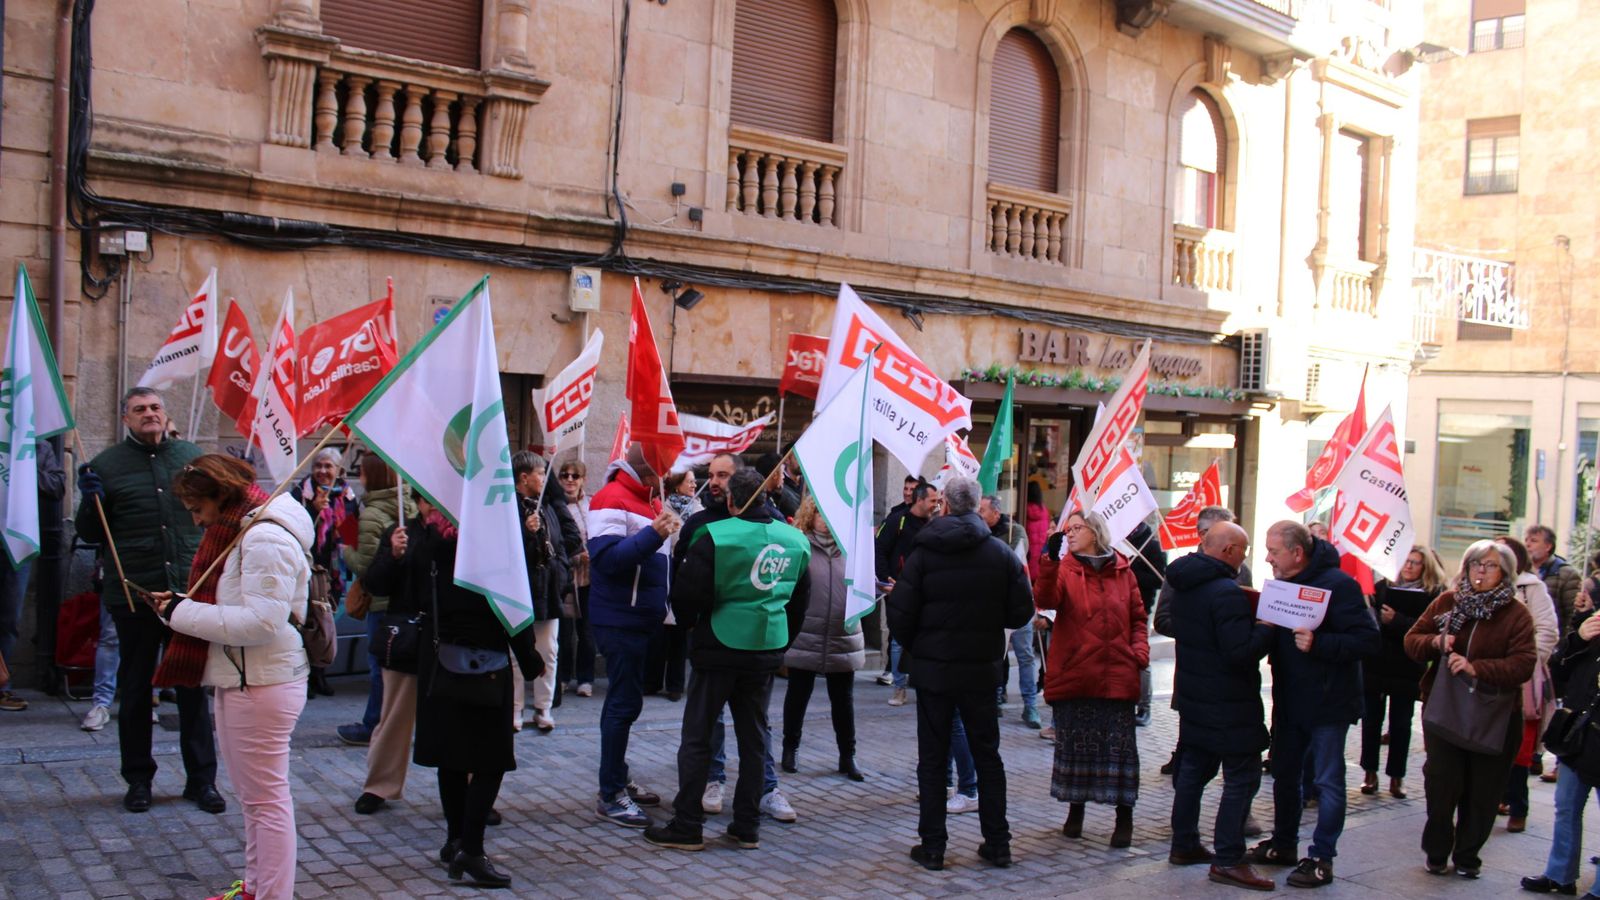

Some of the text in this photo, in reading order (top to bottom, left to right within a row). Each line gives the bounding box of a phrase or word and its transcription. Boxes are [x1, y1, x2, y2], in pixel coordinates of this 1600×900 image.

[147, 343, 200, 370] salaman
[1018, 328, 1090, 367] BAR
[229, 370, 252, 393] Cas
[551, 369, 597, 424] CCO
[561, 420, 585, 437] sala
[873, 398, 897, 422] tilla
[895, 421, 908, 431] y
[272, 418, 294, 457] León
[1383, 520, 1405, 556] León
